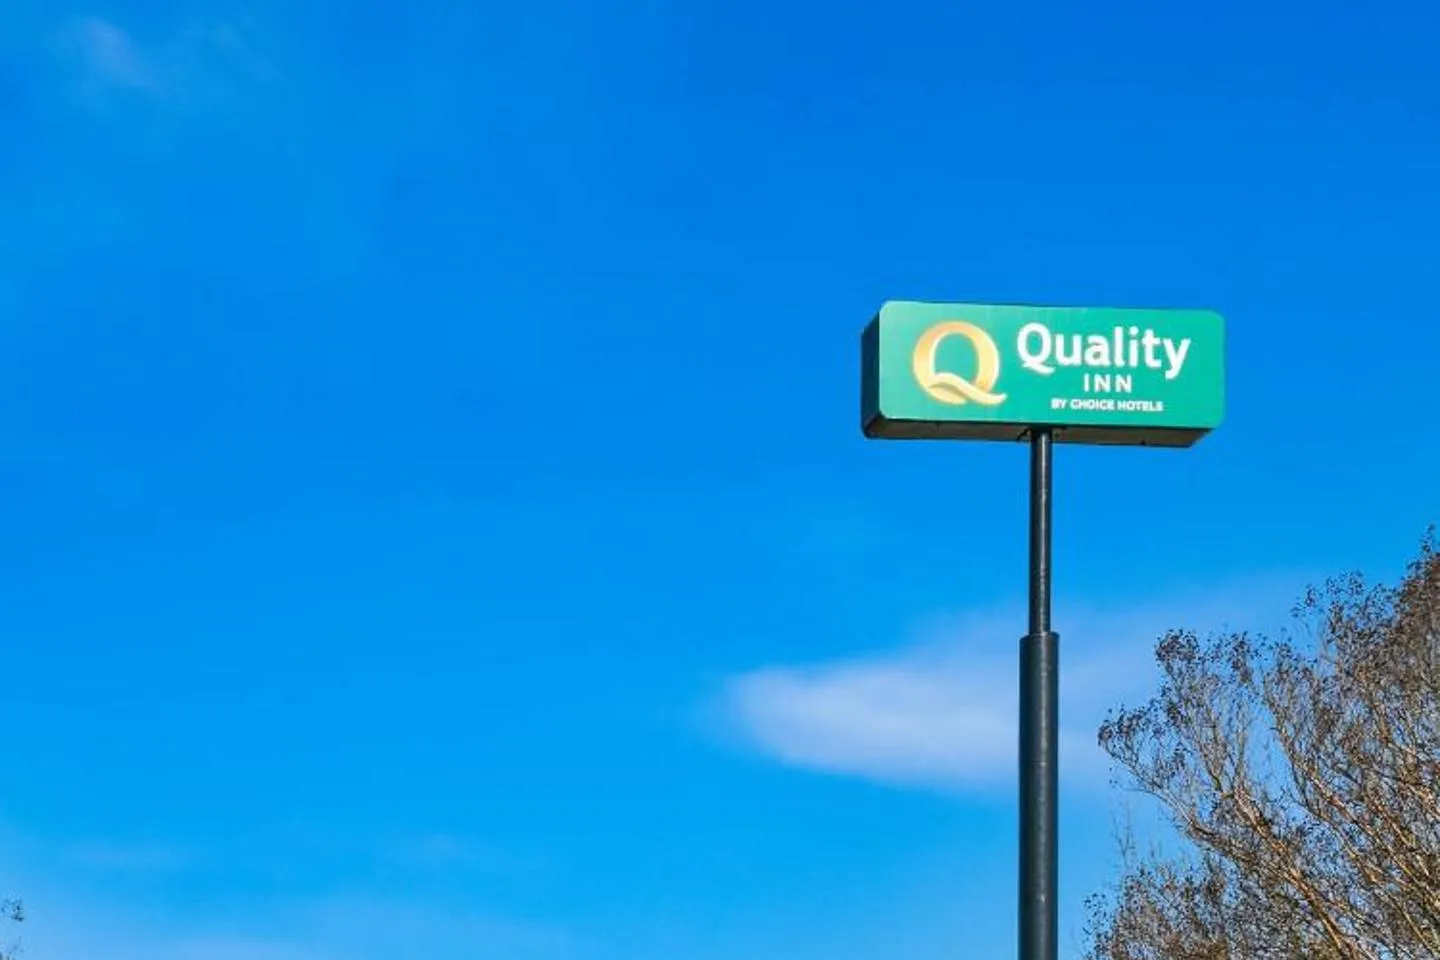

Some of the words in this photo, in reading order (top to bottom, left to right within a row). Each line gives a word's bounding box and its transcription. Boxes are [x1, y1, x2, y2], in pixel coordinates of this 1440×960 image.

[913, 320, 1007, 405] Q
[1016, 322, 1192, 378] Quality
[1083, 373, 1133, 393] INN
[1051, 398, 1068, 409] BY
[1070, 398, 1116, 411] CHOICE
[1117, 400, 1164, 412] HOTELS
